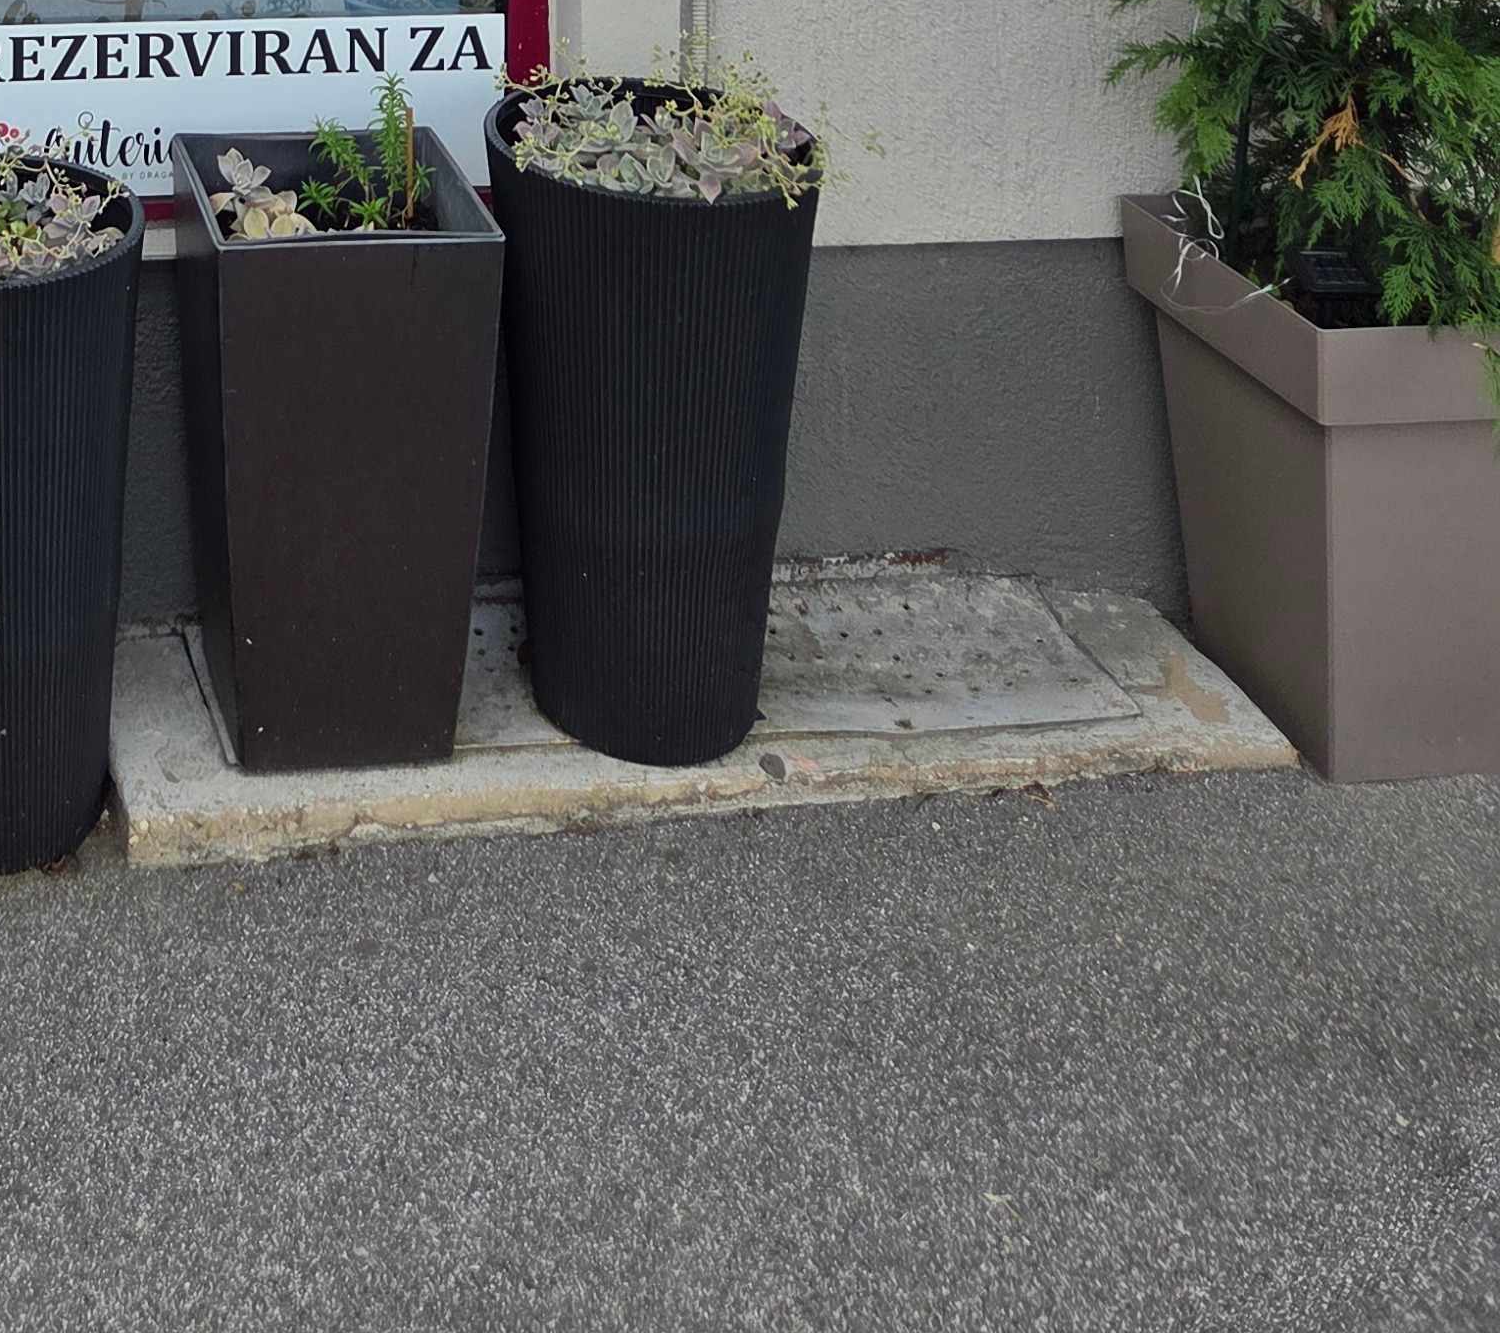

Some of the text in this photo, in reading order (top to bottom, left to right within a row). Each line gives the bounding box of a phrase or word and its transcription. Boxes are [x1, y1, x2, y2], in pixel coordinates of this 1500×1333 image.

[409, 25, 494, 72] ZA
[121, 170, 175, 181] BY DRAGA
